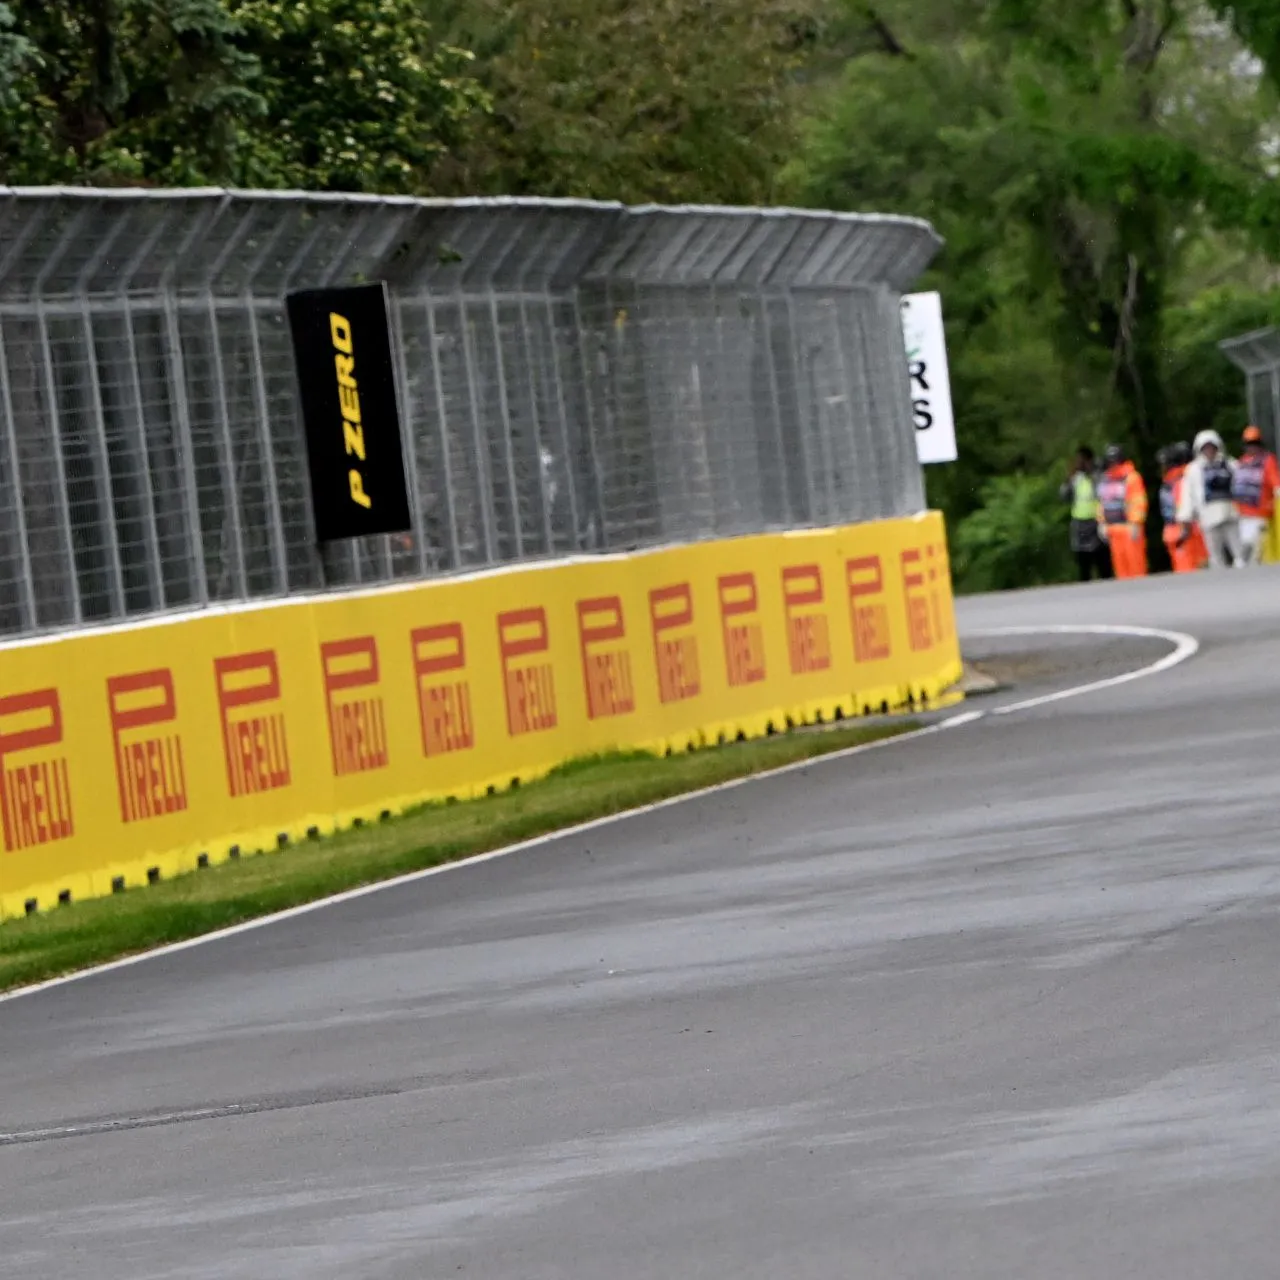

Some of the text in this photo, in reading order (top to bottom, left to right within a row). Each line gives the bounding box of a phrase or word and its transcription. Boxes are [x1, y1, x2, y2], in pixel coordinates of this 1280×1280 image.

[329, 312, 372, 509] P ZERO
[107, 667, 188, 824] PIRELLI
[213, 649, 291, 797] PIRELLI
[320, 635, 389, 777] PIRELLI
